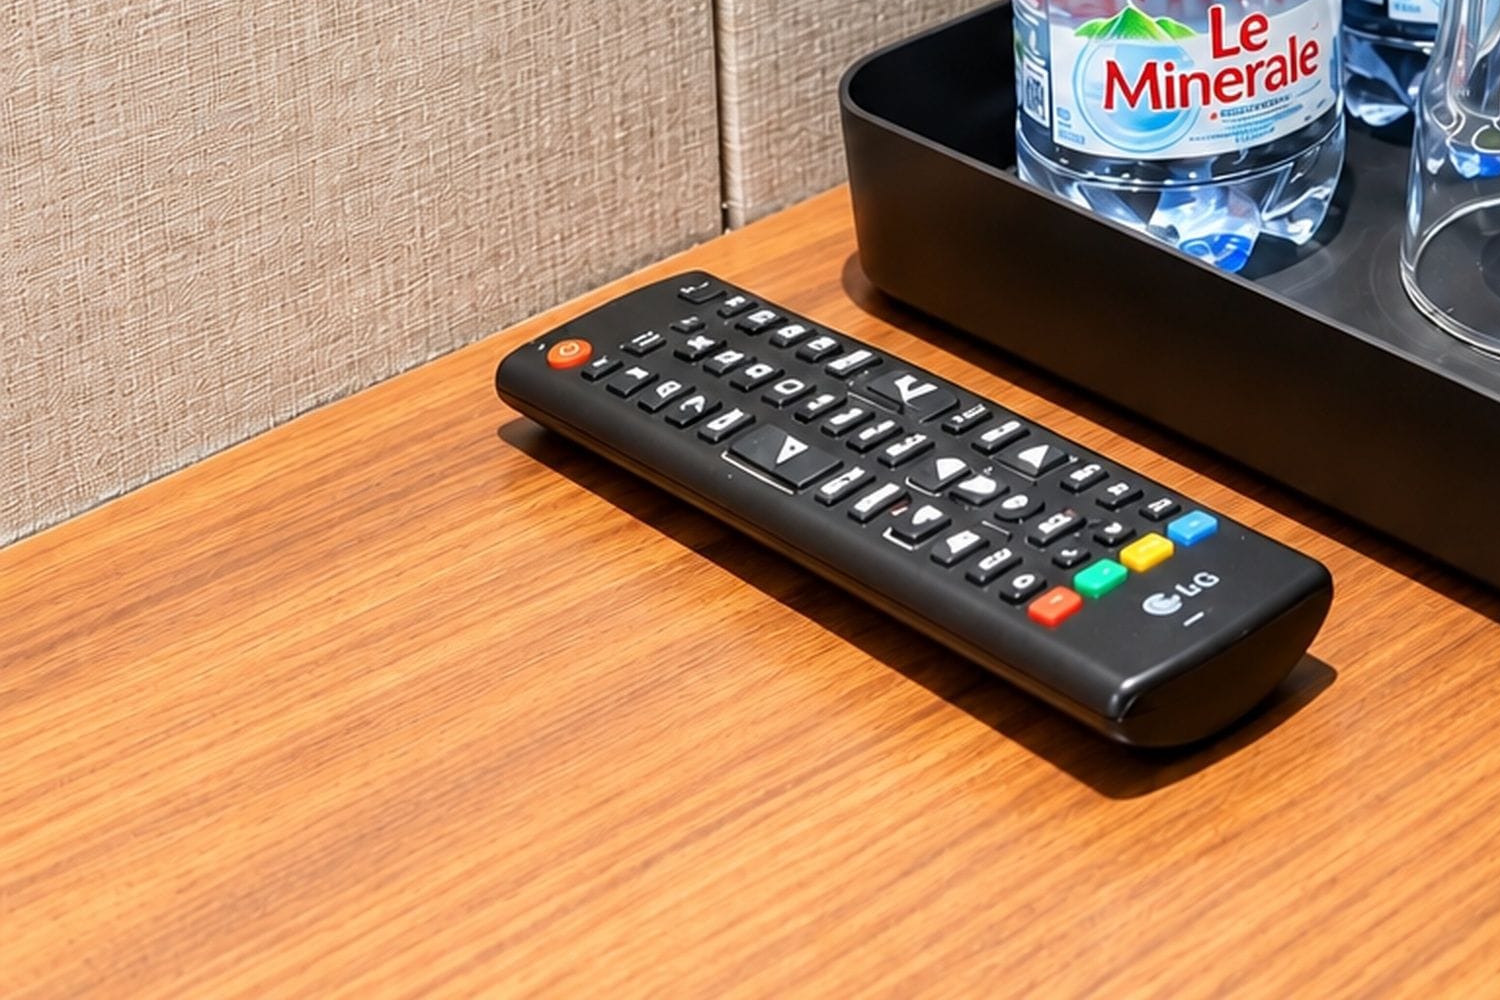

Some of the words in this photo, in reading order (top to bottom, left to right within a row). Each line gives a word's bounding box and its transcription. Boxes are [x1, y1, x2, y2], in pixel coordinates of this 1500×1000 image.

[1209, 6, 1269, 59] Le
[1104, 37, 1319, 110] Minerale
[1174, 571, 1220, 597] LG
